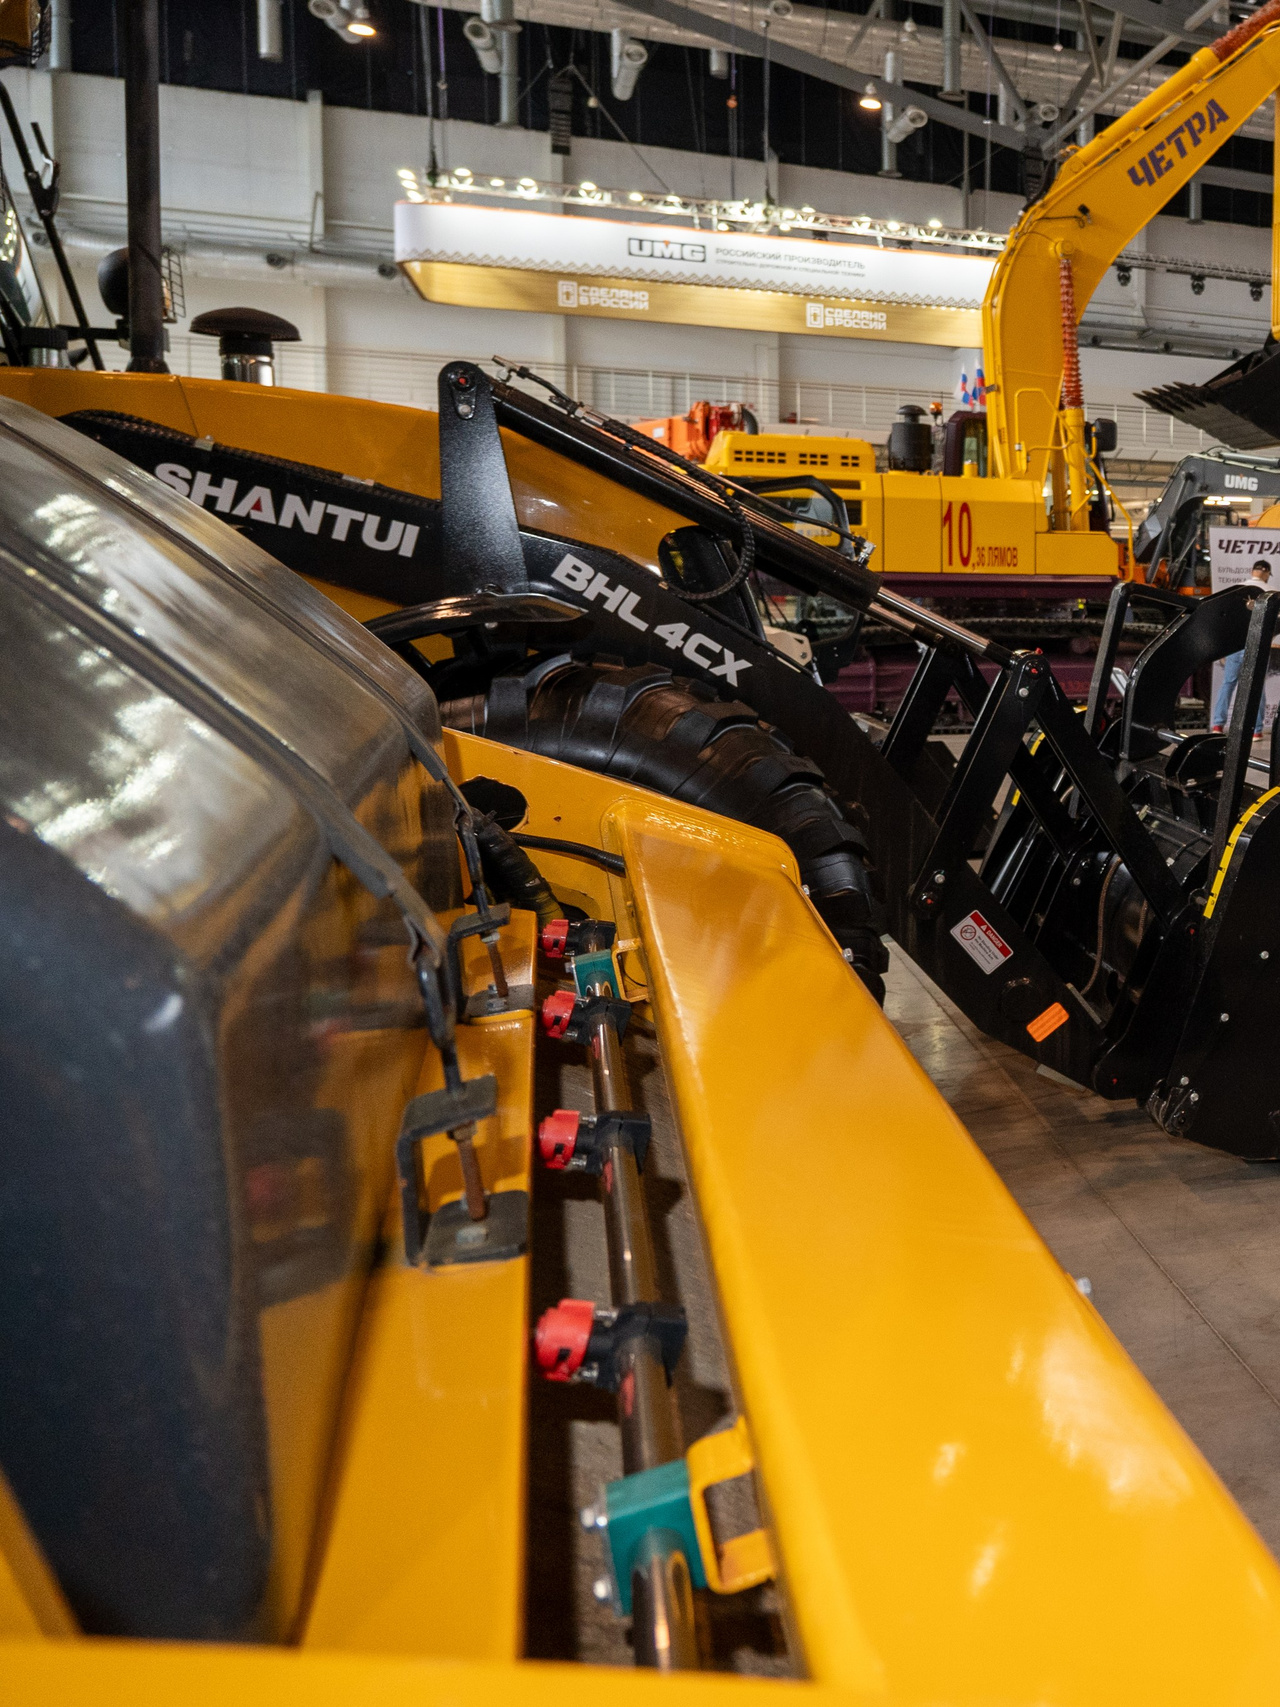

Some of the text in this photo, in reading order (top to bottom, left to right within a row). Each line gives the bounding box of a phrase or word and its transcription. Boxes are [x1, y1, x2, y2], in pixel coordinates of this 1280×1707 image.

[1127, 99, 1229, 187] ЧЕТРА
[628, 238, 706, 262] UMG
[715, 247, 866, 269] РОССИЙСКИЙ ПРОИЗВОДИТЕЛЬ
[579, 286, 649, 301] СДЕЛАНО
[590, 296, 649, 310] РОССИИ
[825, 307, 887, 322] СДЕЛАНО
[835, 317, 887, 330] РОССИИ
[1224, 474, 1259, 491] UMG
[154, 462, 421, 558] SHANTUI
[551, 554, 754, 687] BHL 4CX
